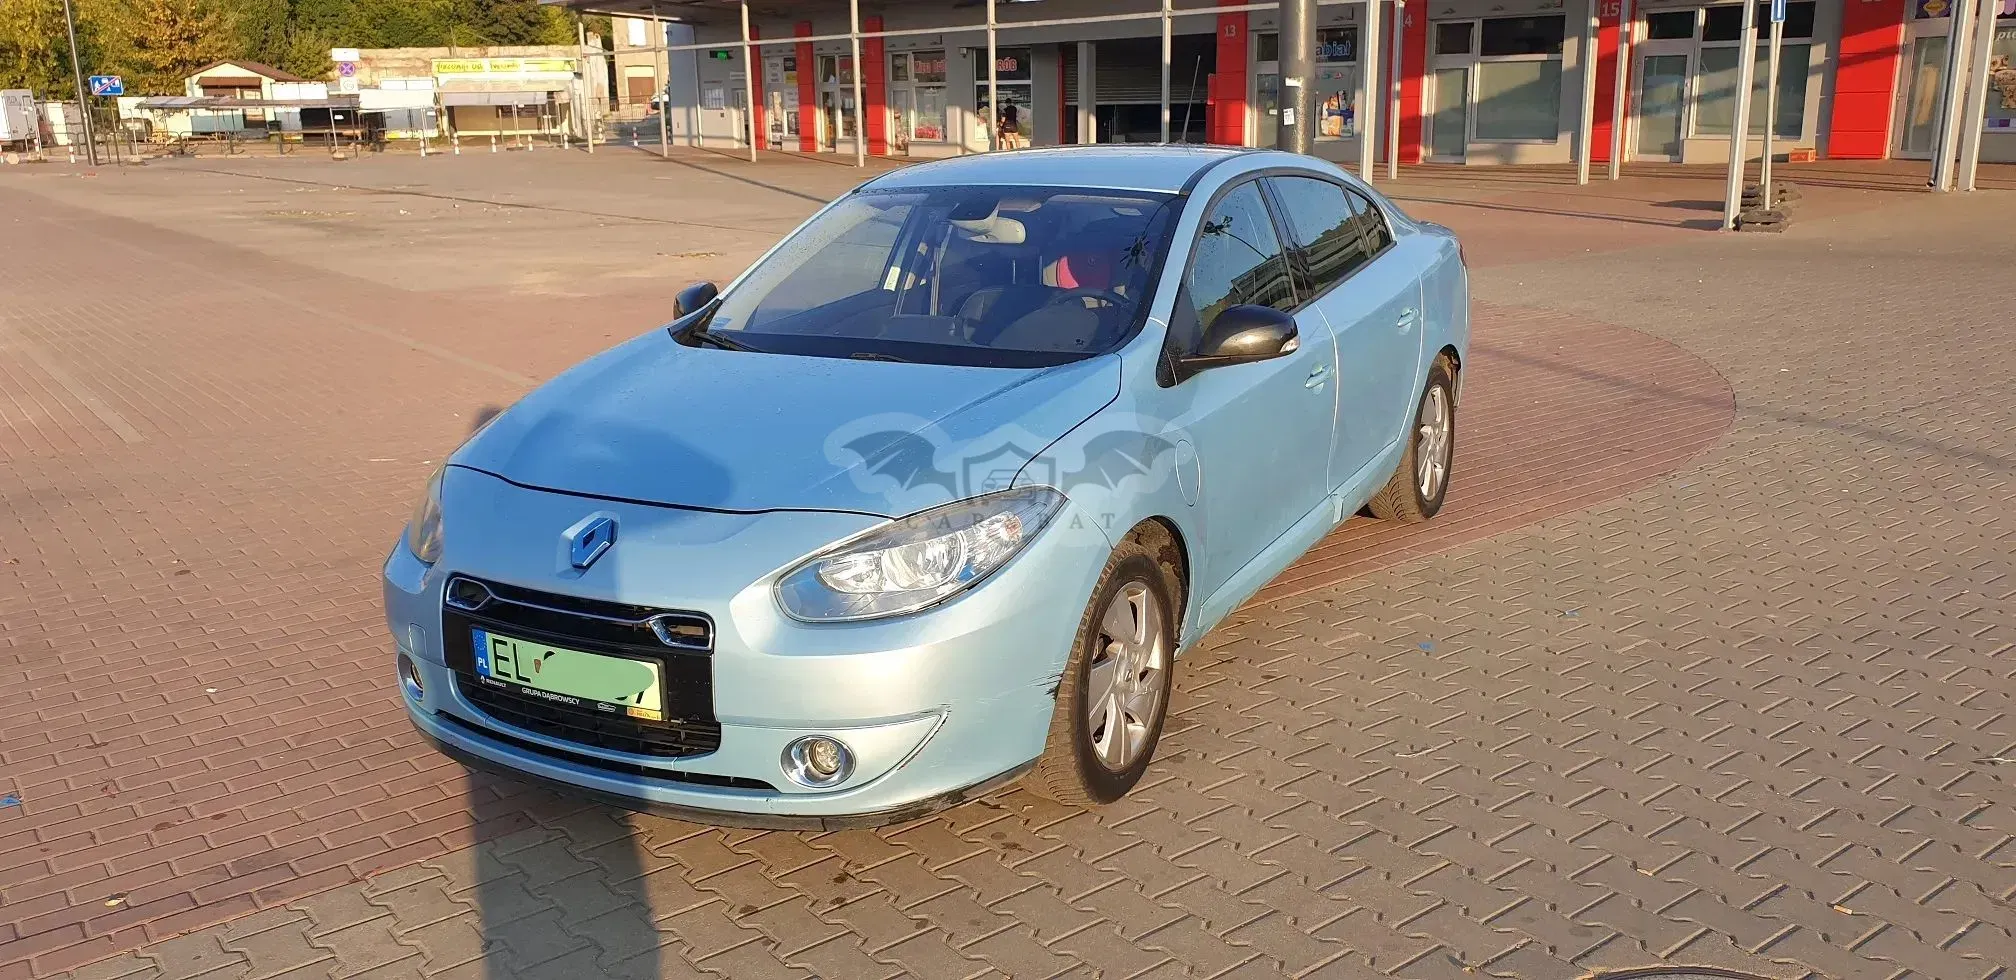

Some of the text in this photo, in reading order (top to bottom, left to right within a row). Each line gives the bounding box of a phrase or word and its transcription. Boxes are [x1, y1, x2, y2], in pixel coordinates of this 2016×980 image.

[1602, 2, 1620, 17] 15
[1224, 24, 1237, 38] 13
[1316, 40, 1351, 56] abiał
[996, 56, 1018, 71] RÓB
[478, 657, 488, 668] PL
[492, 637, 531, 683] EL
[521, 687, 580, 706] GRUPA DĄBROWSCY
